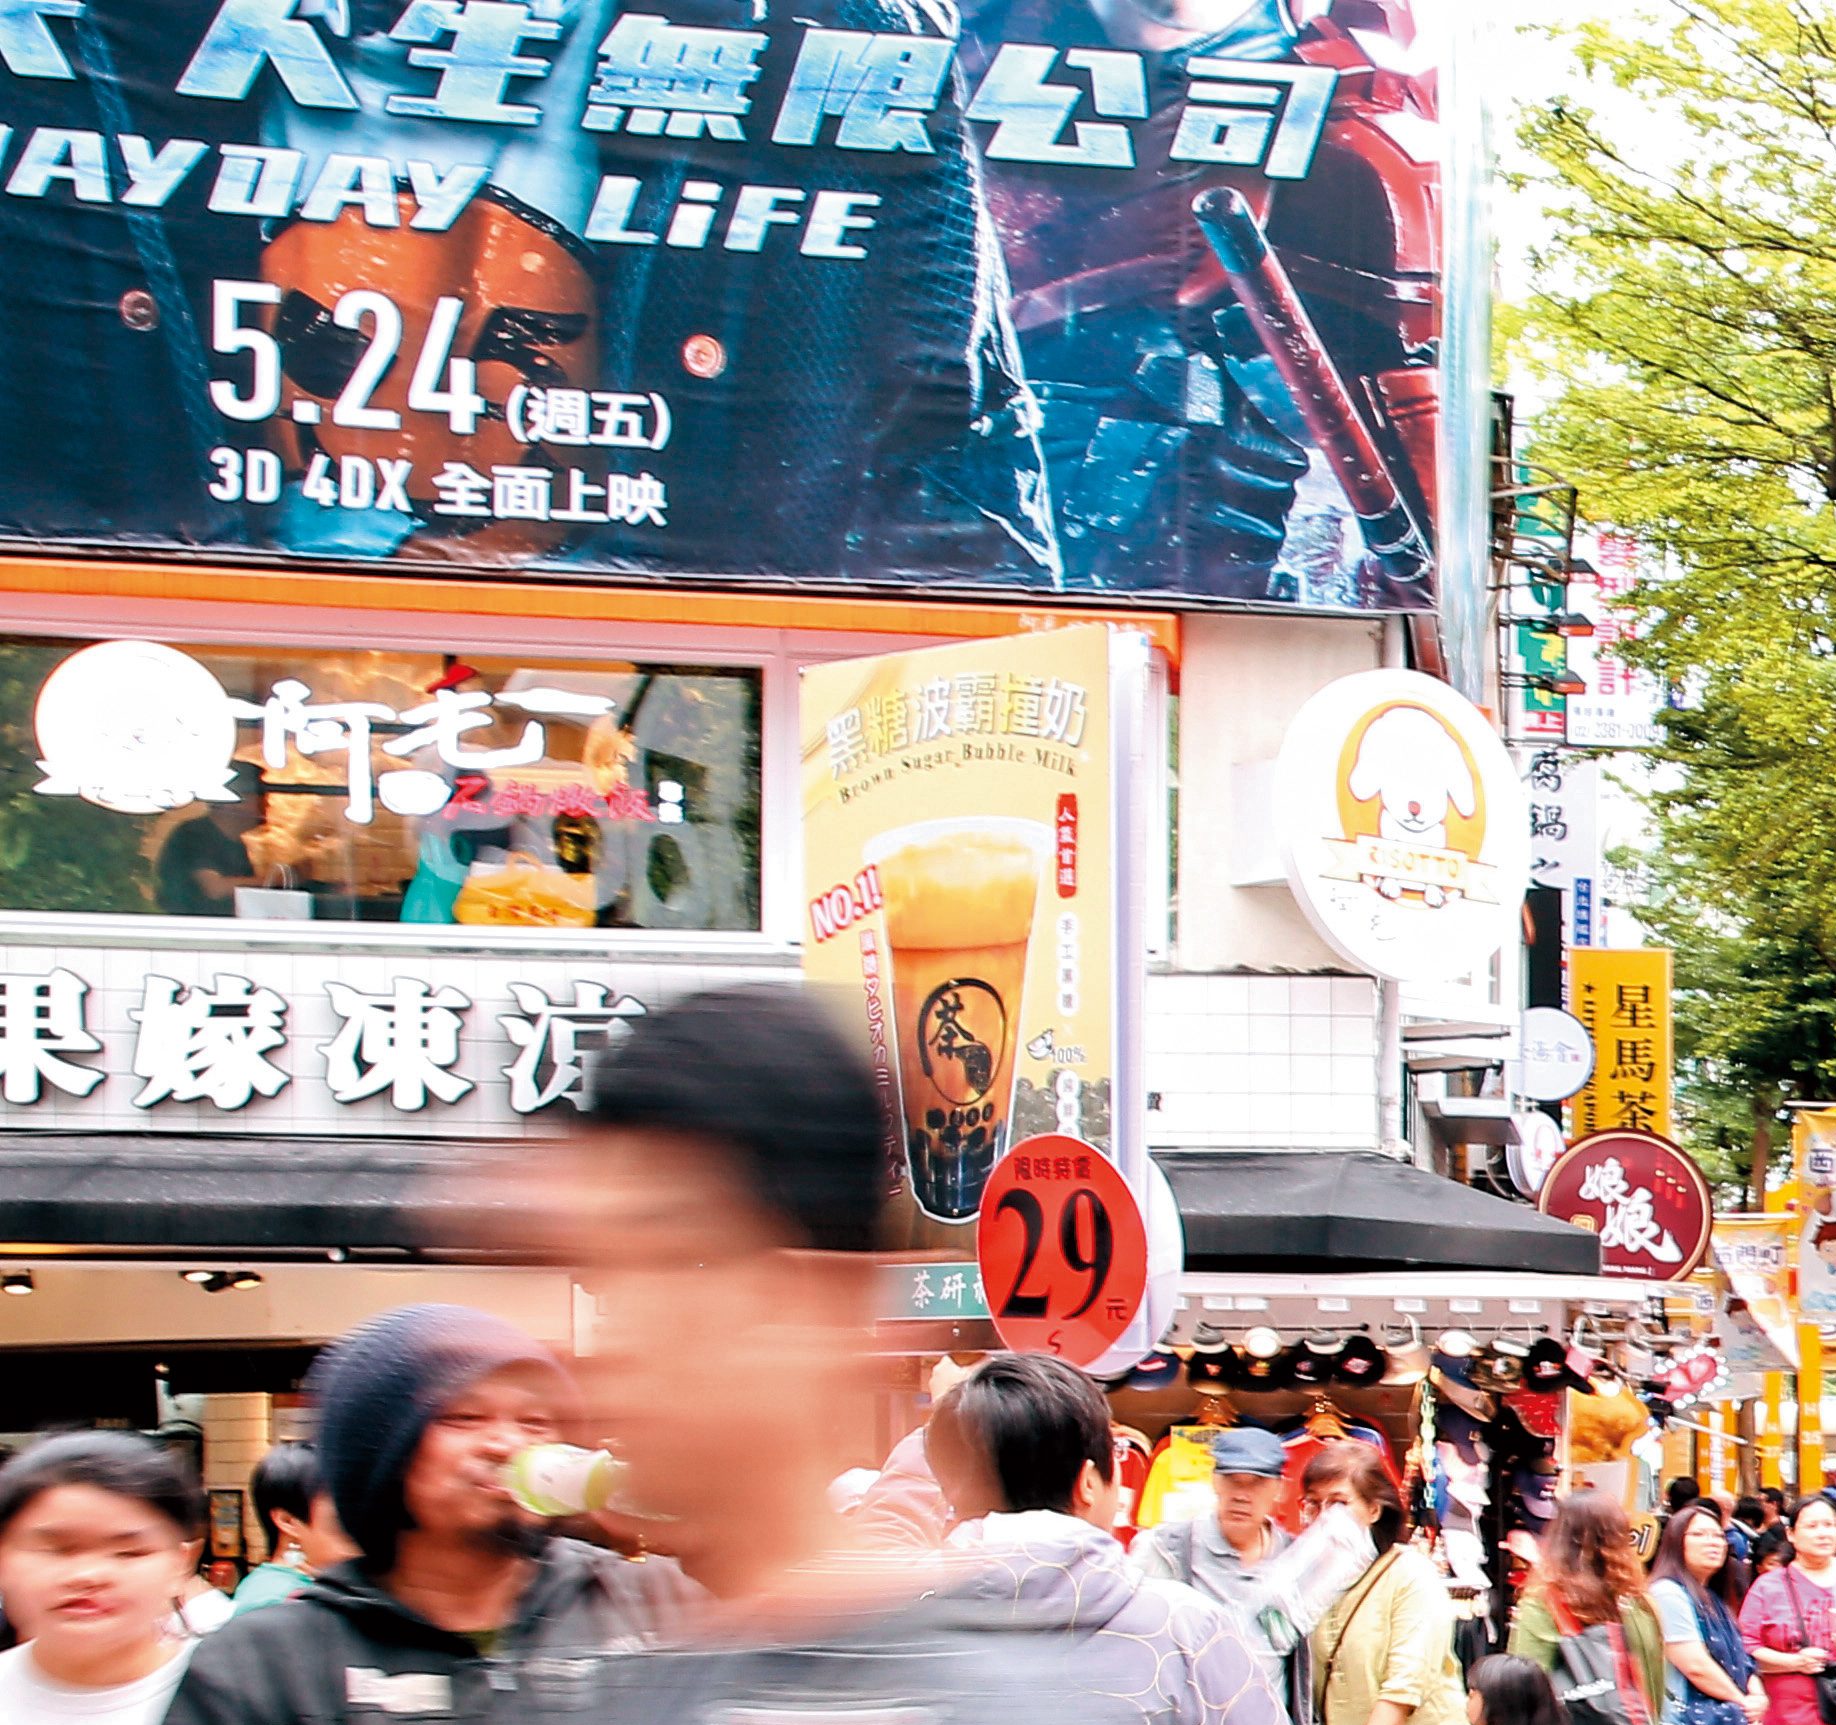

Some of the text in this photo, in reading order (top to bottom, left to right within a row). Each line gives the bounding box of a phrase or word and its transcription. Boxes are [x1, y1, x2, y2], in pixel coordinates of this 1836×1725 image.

[175, 0, 1340, 181] 人生無限公司
[0, 123, 494, 232] AYDAY
[207, 279, 671, 453] 5.24 (週五)
[208, 446, 668, 529] 3D 4DX 全面上映
[825, 671, 1088, 781] 黑糖波霸撞奶
[838, 742, 1077, 804] Brown Sugar Bubble Milk
[809, 863, 885, 944] NO.1!
[996, 1188, 1129, 1321] 29 元
[1578, 1156, 1685, 1264] 娘娘
